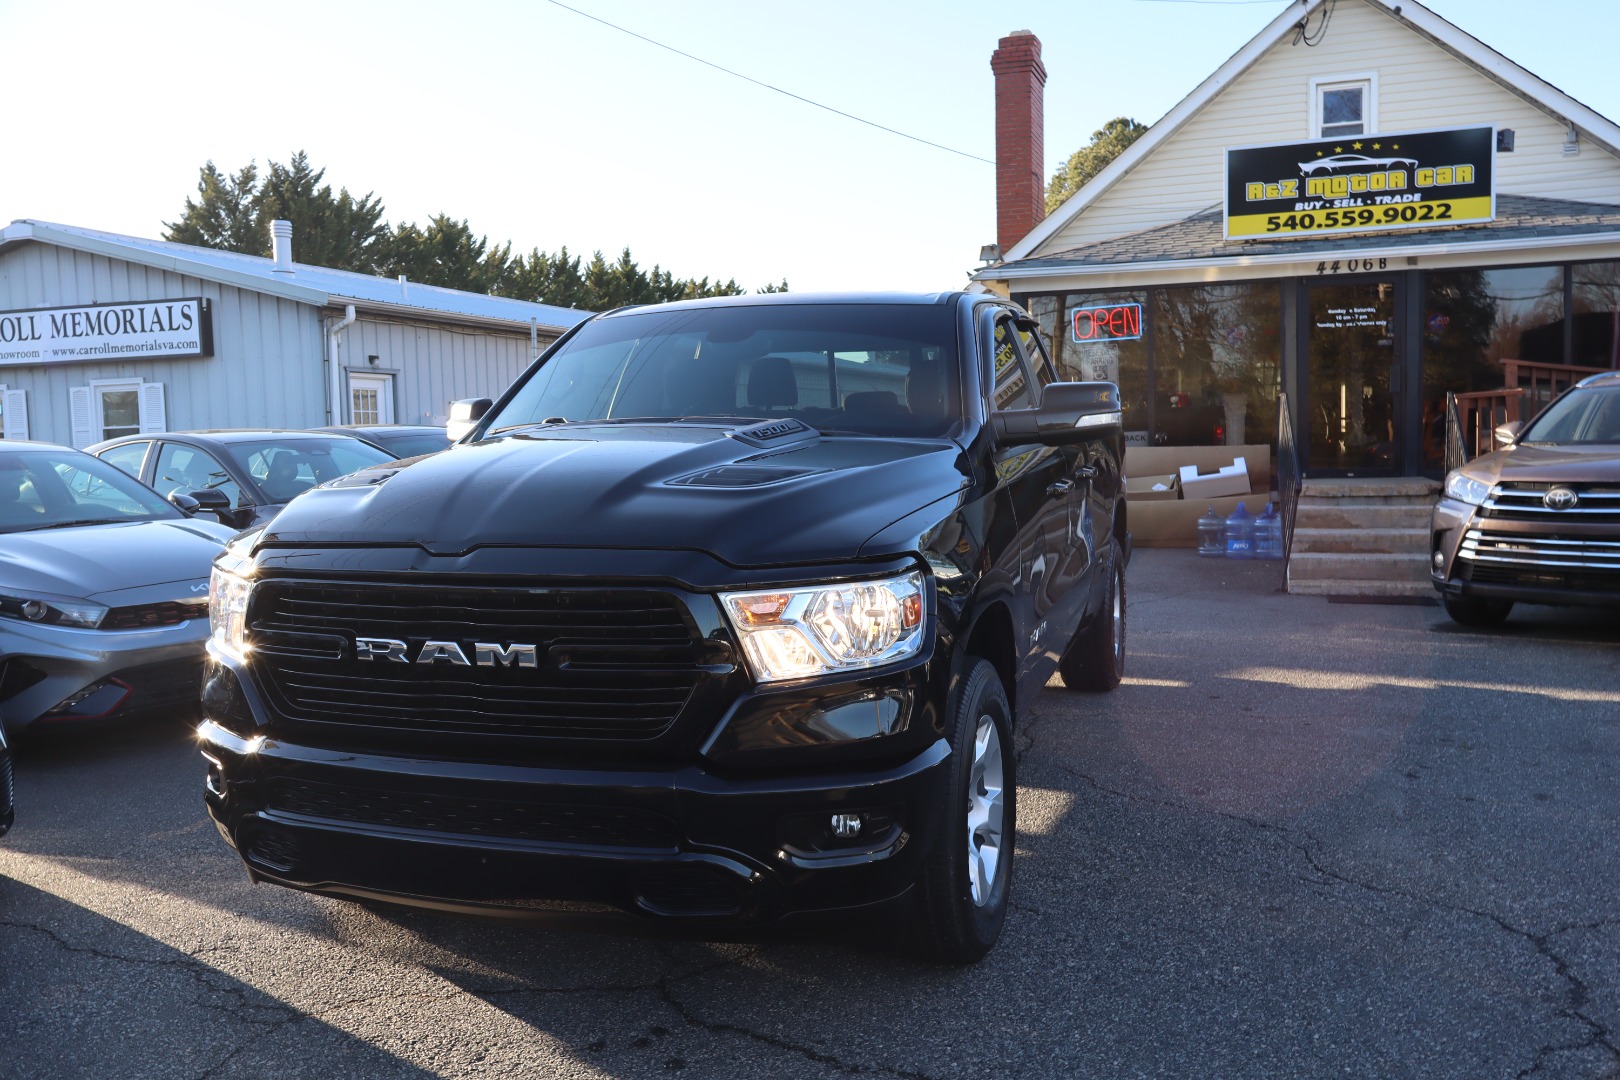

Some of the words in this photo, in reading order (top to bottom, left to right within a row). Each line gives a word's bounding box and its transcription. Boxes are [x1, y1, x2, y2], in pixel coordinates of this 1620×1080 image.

[1246, 179, 1299, 202] R&Z
[1294, 200, 1324, 211] BUY
[1333, 197, 1364, 209] SELL
[1374, 193, 1422, 205] TRADE
[1266, 203, 1452, 232] 540.559.9022
[1316, 258, 1387, 275] 4406B
[0, 315, 42, 342] OLL
[49, 304, 193, 339] MEMORIALS
[1075, 306, 1139, 339] OPEN
[52, 339, 198, 356] www.carrollmemorialsva.com
[356, 637, 538, 668] RAM
